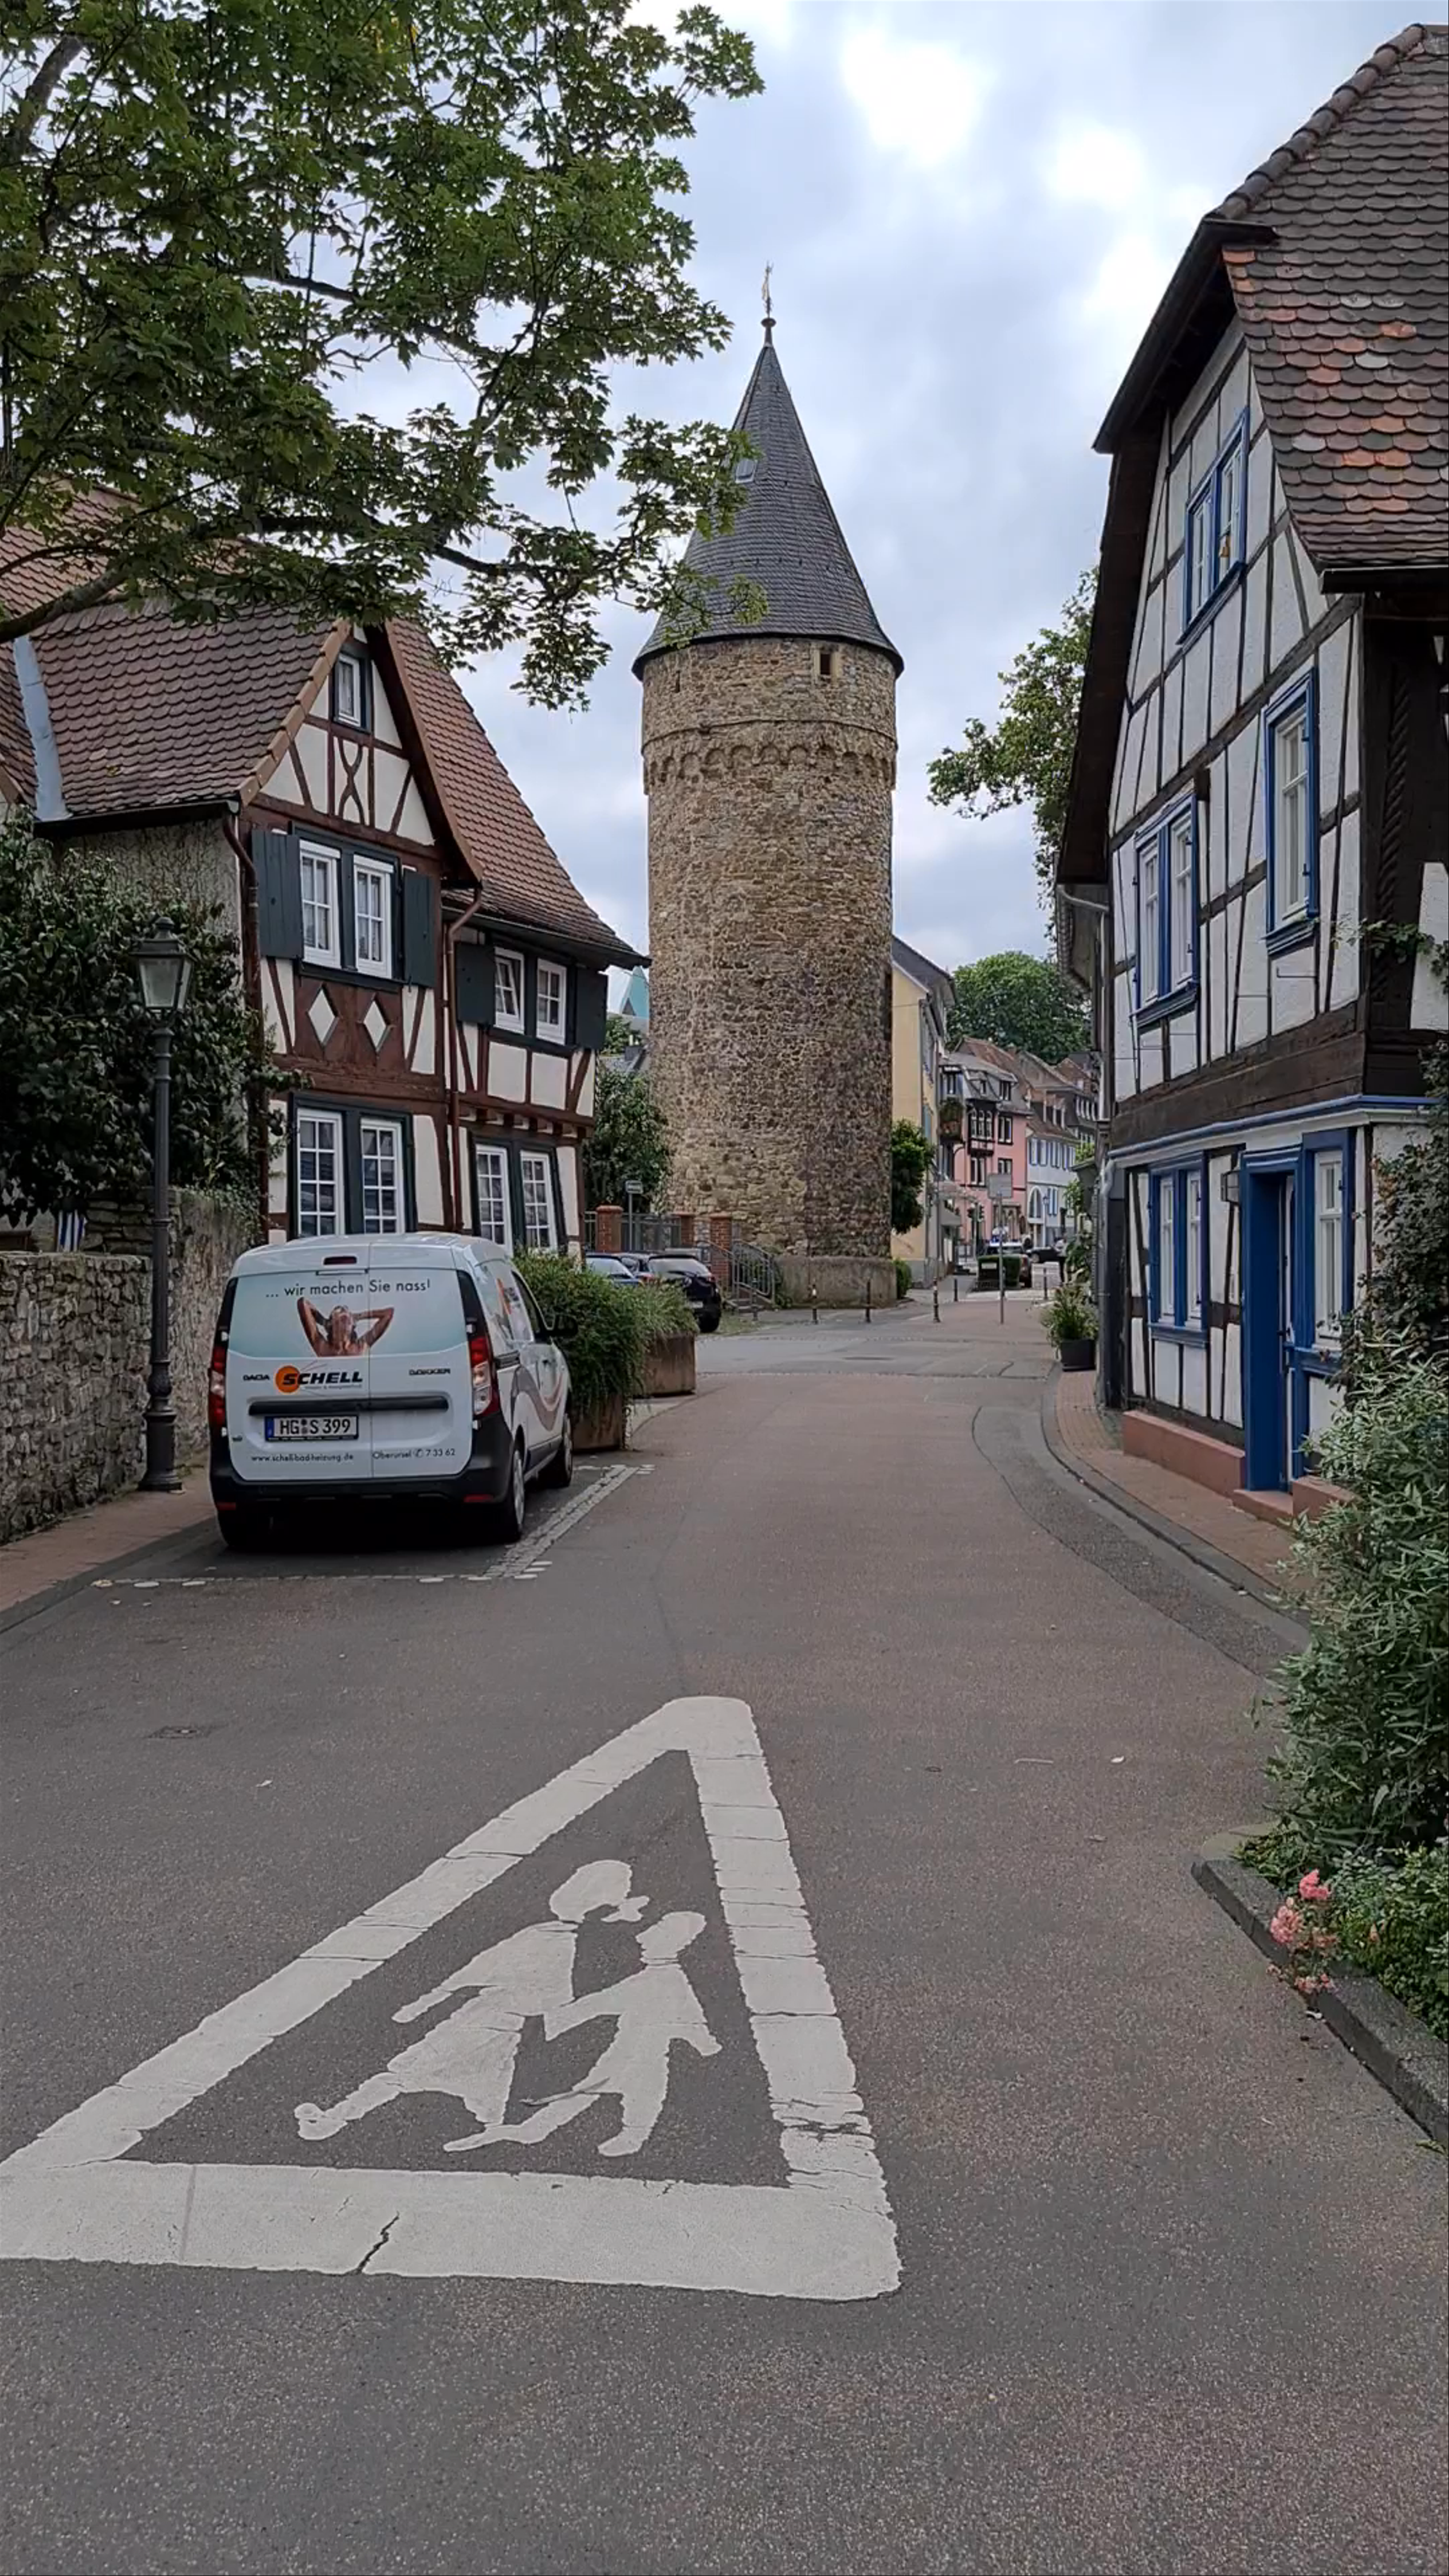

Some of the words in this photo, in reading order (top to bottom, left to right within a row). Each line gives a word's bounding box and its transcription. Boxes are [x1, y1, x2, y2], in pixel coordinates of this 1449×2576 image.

[284, 1284, 305, 1296] wir
[310, 1281, 363, 1295] machen
[369, 1280, 391, 1292] Sie
[396, 1279, 430, 1291] nass!
[282, 1372, 363, 1385] SCHELL
[280, 1419, 299, 1435] HG
[310, 1419, 319, 1434] S
[322, 1419, 351, 1433] 399
[445, 1448, 455, 1456] 62
